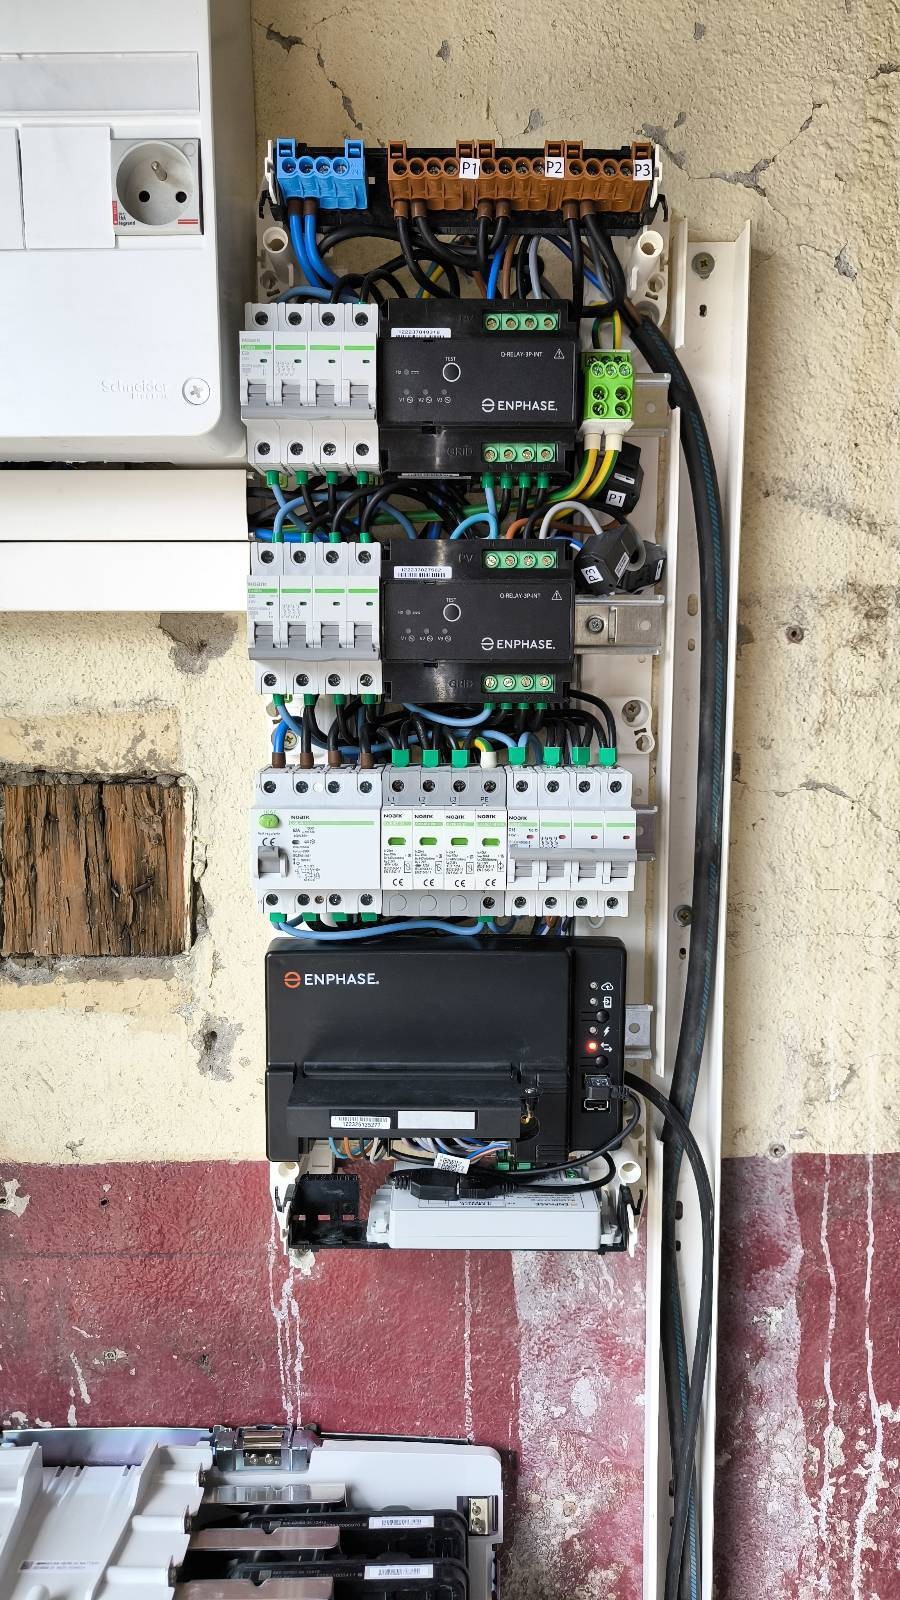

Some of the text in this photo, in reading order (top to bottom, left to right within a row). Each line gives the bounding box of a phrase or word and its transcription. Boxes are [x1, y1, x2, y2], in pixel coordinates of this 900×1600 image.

[462, 162, 478, 175] P1
[546, 160, 563, 174] P2
[635, 163, 651, 177] P3
[608, 493, 623, 504] P1
[585, 567, 599, 582] P3
